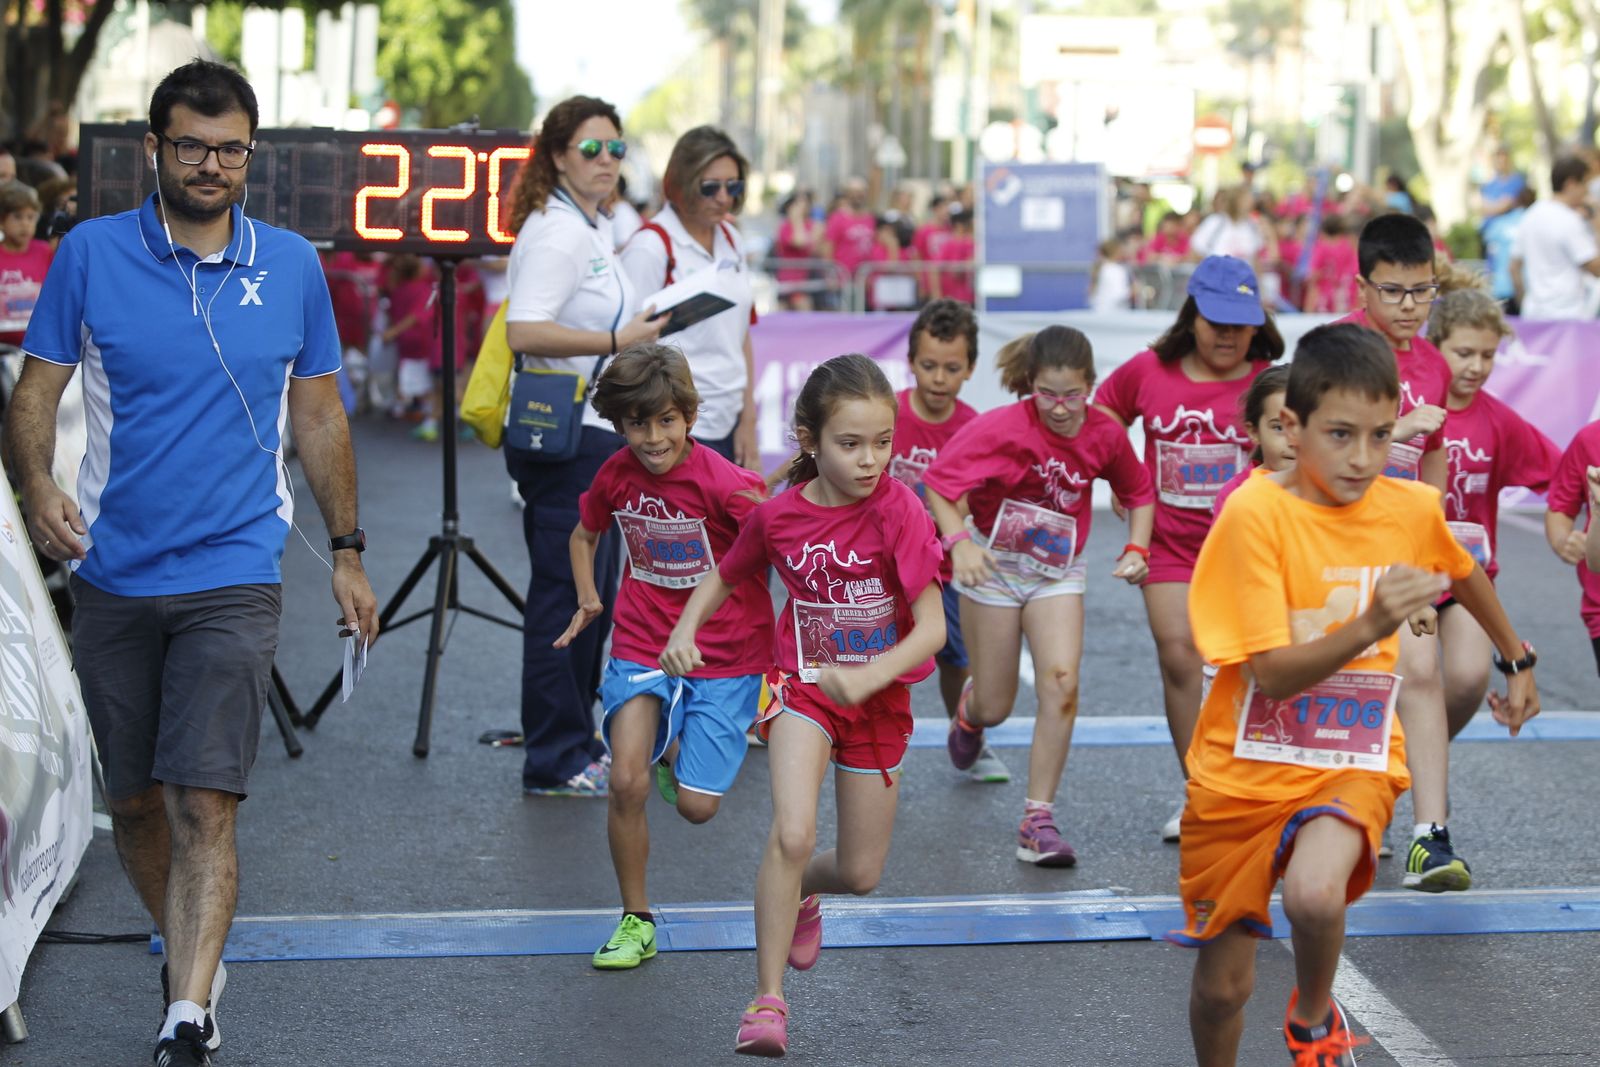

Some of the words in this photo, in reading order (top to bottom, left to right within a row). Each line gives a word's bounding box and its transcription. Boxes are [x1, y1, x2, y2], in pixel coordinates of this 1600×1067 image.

[645, 539, 705, 561] 1683
[666, 560, 702, 570] FRANCISCO
[850, 577, 881, 589] CARRER
[852, 585, 883, 596] SOLIDARI
[836, 654, 868, 663] MEJORES
[1293, 696, 1384, 729] 1706
